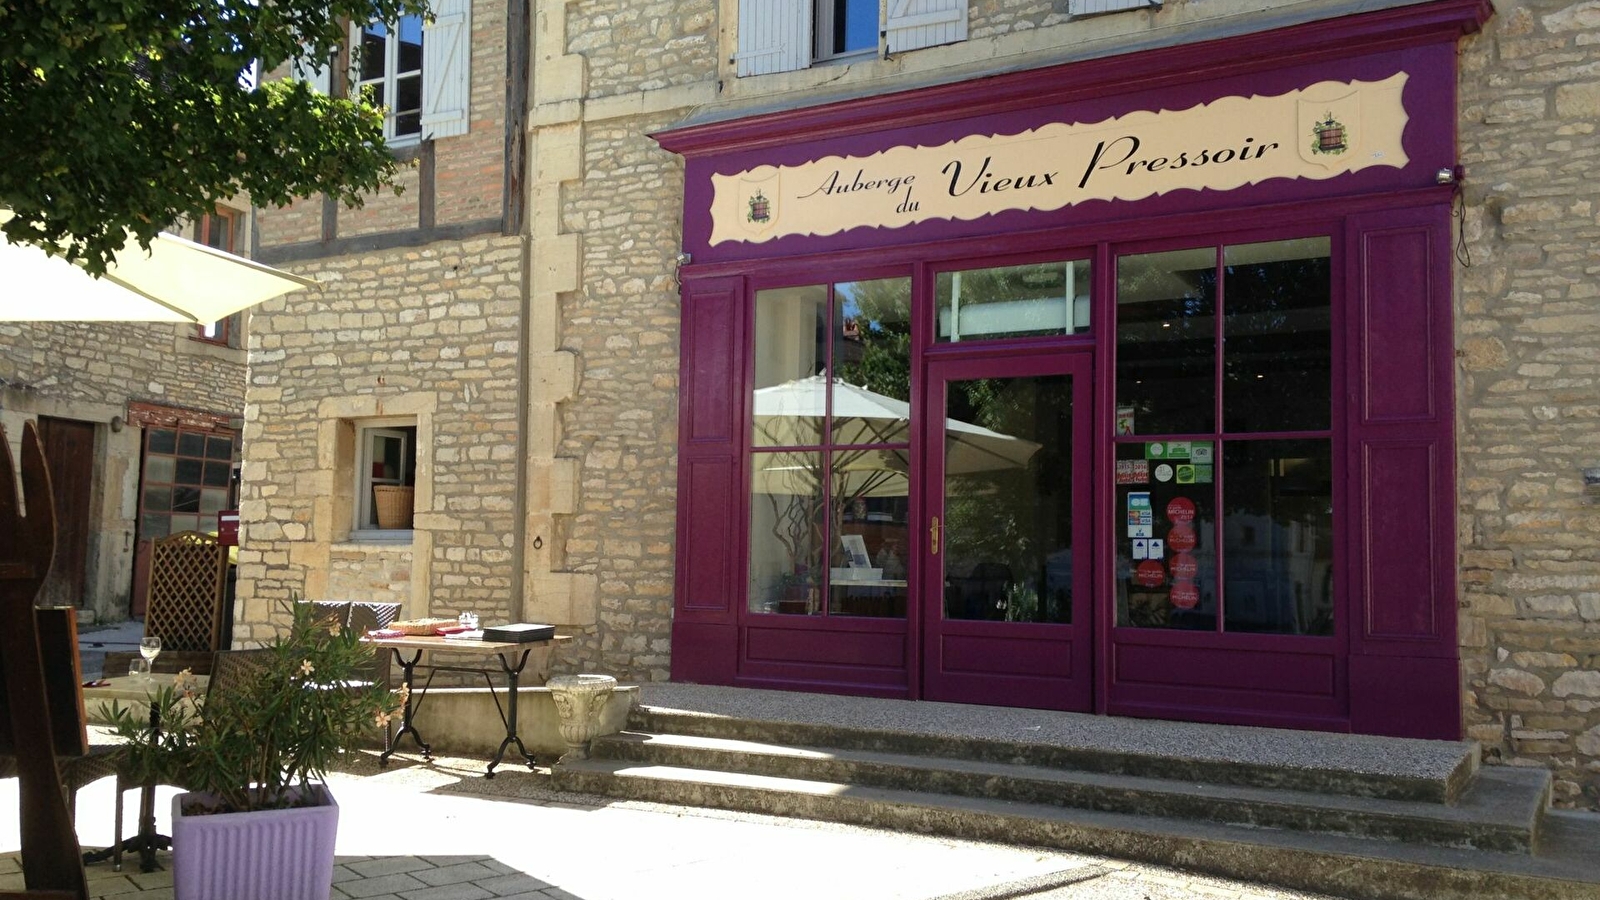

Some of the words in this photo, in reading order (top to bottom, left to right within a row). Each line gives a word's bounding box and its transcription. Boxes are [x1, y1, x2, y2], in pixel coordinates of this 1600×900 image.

[941, 156, 1059, 198] Vieux
[1077, 135, 1280, 189] Pressoir
[797, 169, 916, 199] Auberge
[896, 186, 920, 214] du
